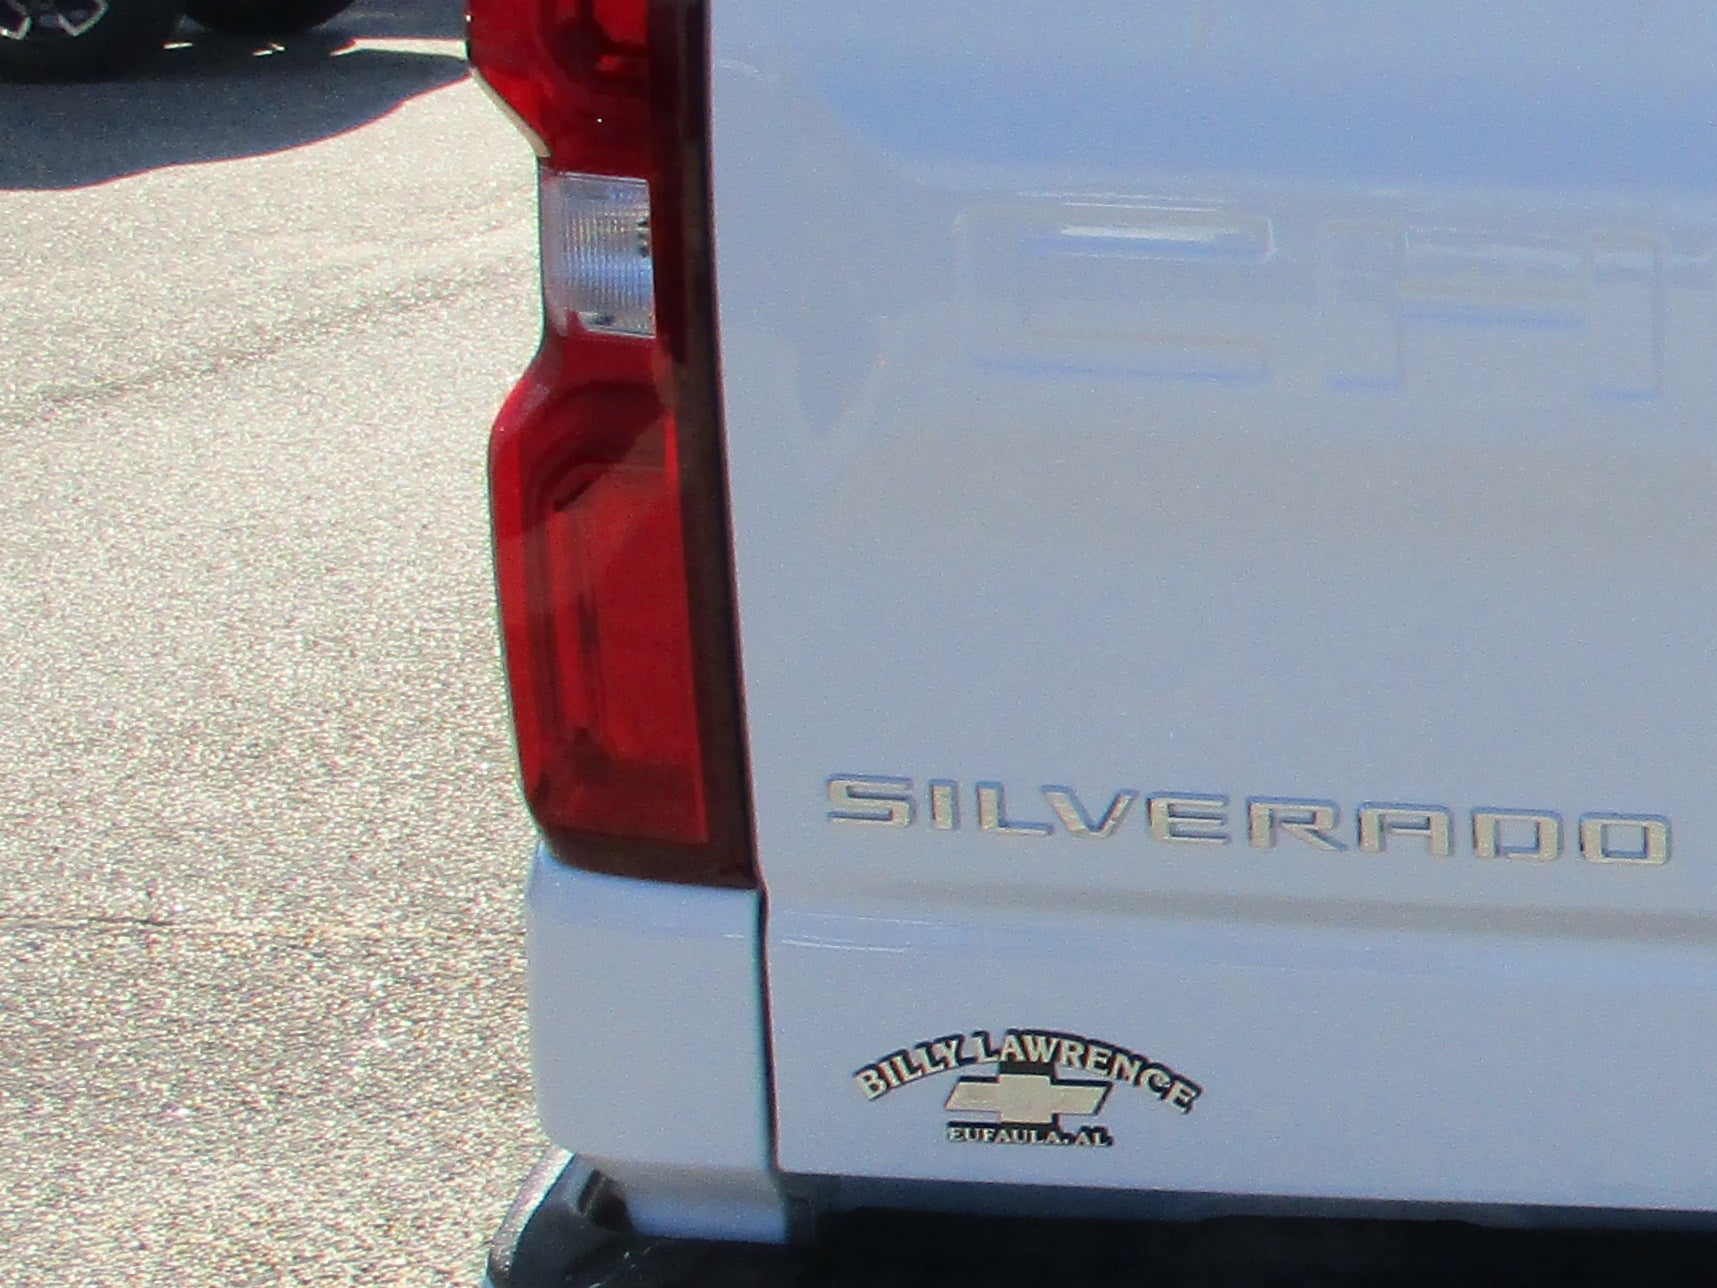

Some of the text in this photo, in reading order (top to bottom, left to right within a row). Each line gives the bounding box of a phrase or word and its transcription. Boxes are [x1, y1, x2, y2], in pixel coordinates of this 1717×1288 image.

[826, 772, 1673, 866] SILVERADO
[853, 1027, 1203, 1114] BILLY LAWRENCE
